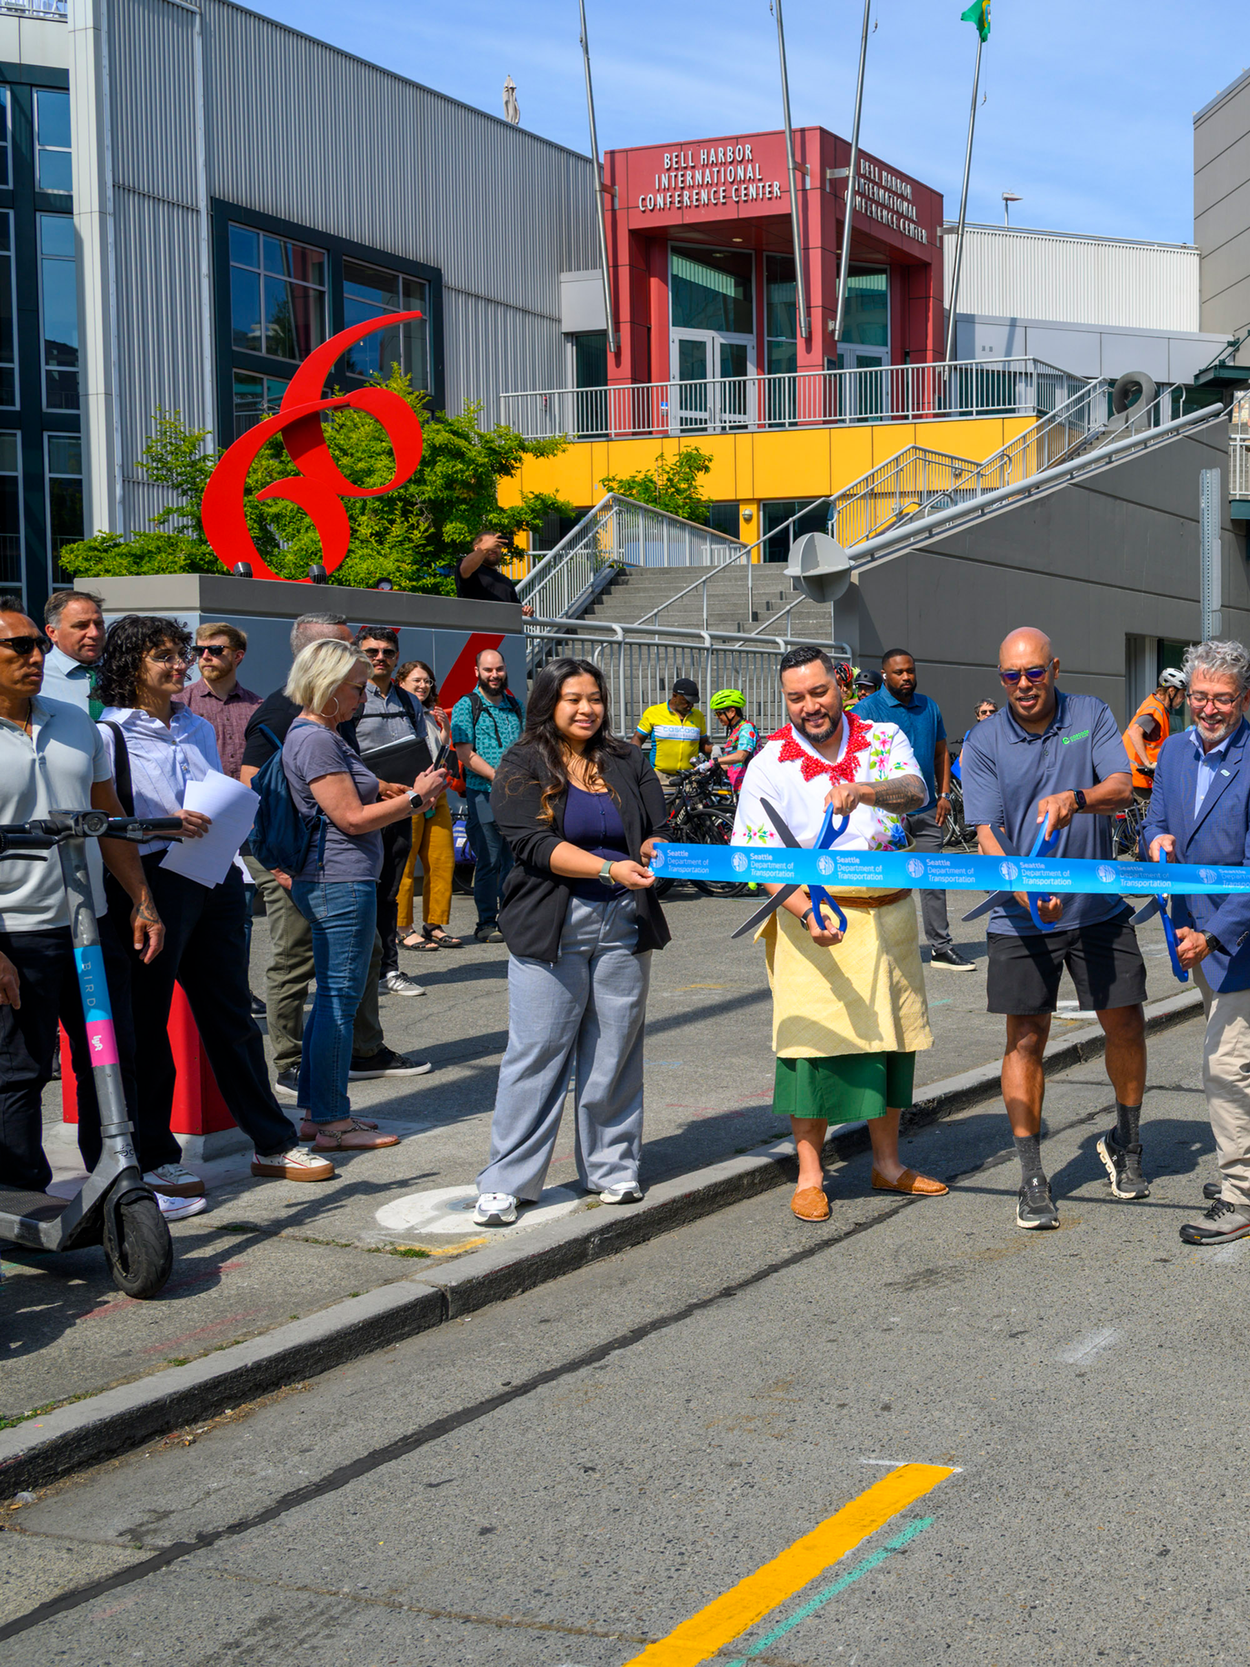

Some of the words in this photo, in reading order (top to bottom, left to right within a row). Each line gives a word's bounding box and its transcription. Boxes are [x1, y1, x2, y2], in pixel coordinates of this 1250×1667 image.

[664, 152, 695, 169] BELL
[700, 144, 754, 165] HARBOR
[655, 163, 763, 190] INTERNATIONAL
[860, 158, 880, 183] BELL
[882, 170, 912, 200] HARBOR
[638, 187, 727, 211] CONFERENCE
[732, 181, 781, 201] CENTER
[855, 175, 918, 222] INTERNATIONAL
[844, 189, 899, 230] CNFERENCE
[900, 218, 928, 245] CENTER
[667, 849, 689, 858] Seattle
[750, 853, 773, 861] Seattle
[667, 857, 702, 866] Department
[836, 855, 860, 864] Seattle
[926, 859, 951, 867] Seattle
[668, 865, 710, 874] Transportation
[751, 860, 786, 869] Department
[787, 862, 794, 870] of
[837, 864, 875, 873] Department
[1020, 861, 1046, 869] Seattle
[751, 868, 795, 878] Transportation
[928, 867, 965, 875] Department
[1021, 869, 1061, 878] Department
[838, 872, 884, 881] Transportation
[928, 874, 976, 883] Transportation
[1022, 877, 1072, 886] Transportation
[1120, 879, 1172, 888] Transportation
[82, 962, 96, 1006] BIRD
[91, 1035, 103, 1051] lyft
